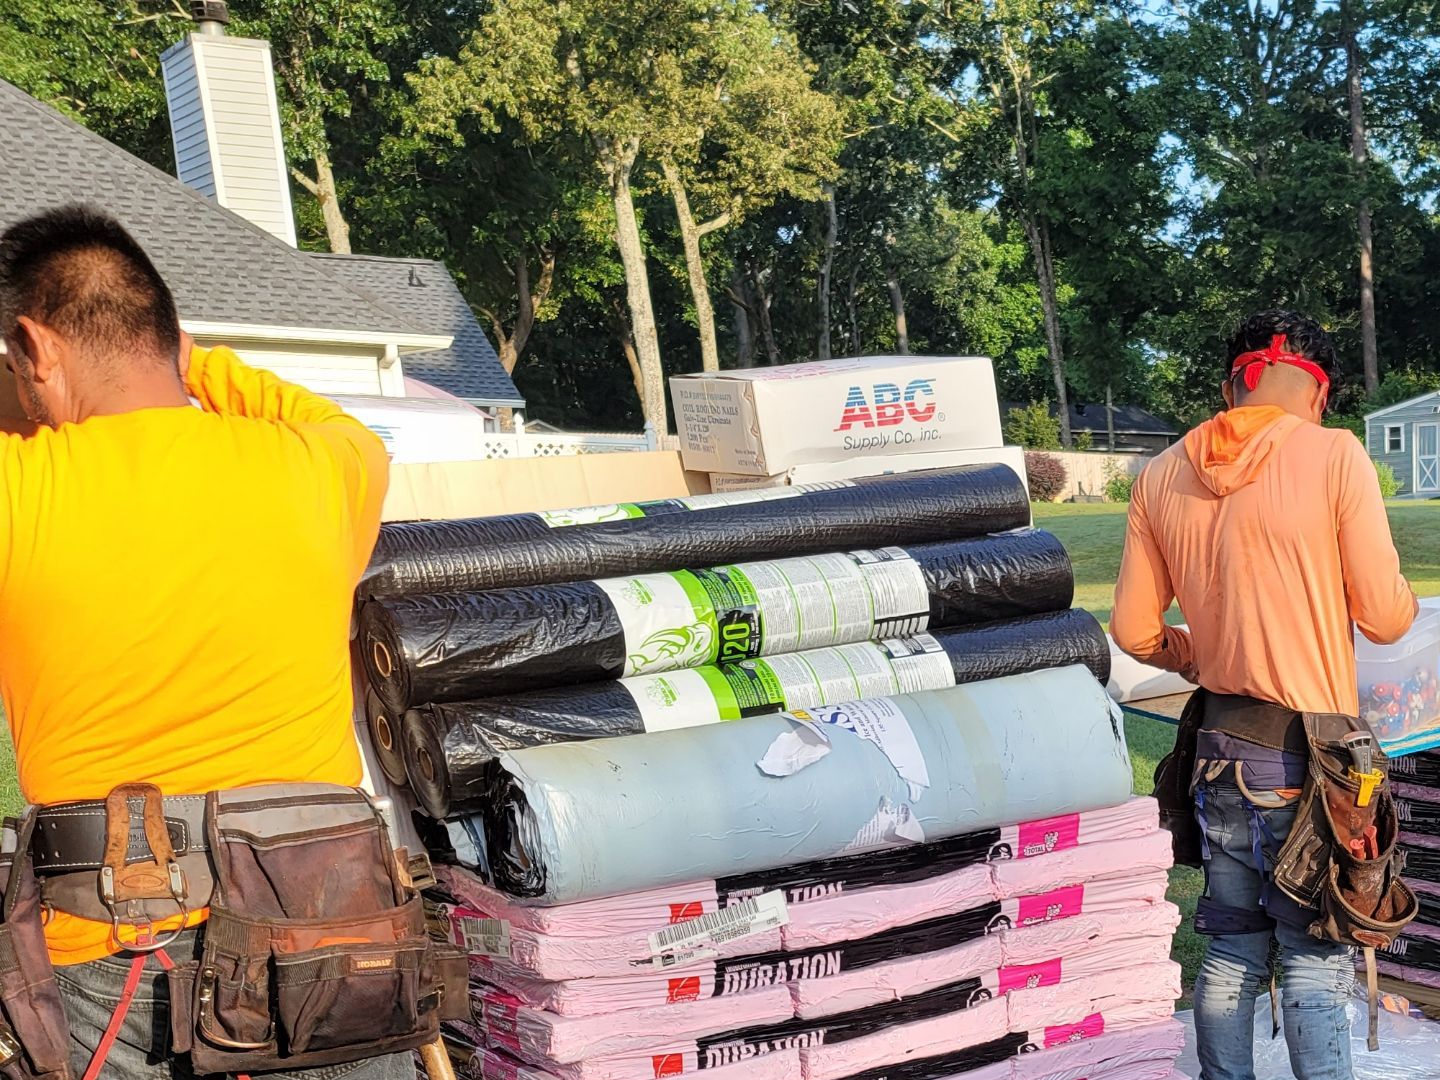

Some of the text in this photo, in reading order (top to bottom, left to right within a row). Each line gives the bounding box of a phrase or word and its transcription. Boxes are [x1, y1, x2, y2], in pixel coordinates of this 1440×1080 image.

[833, 378, 936, 432] ABC
[843, 427, 942, 451] Supply Co. inc.
[1027, 846, 1044, 855] TOTAL
[721, 950, 842, 997] DURATION
